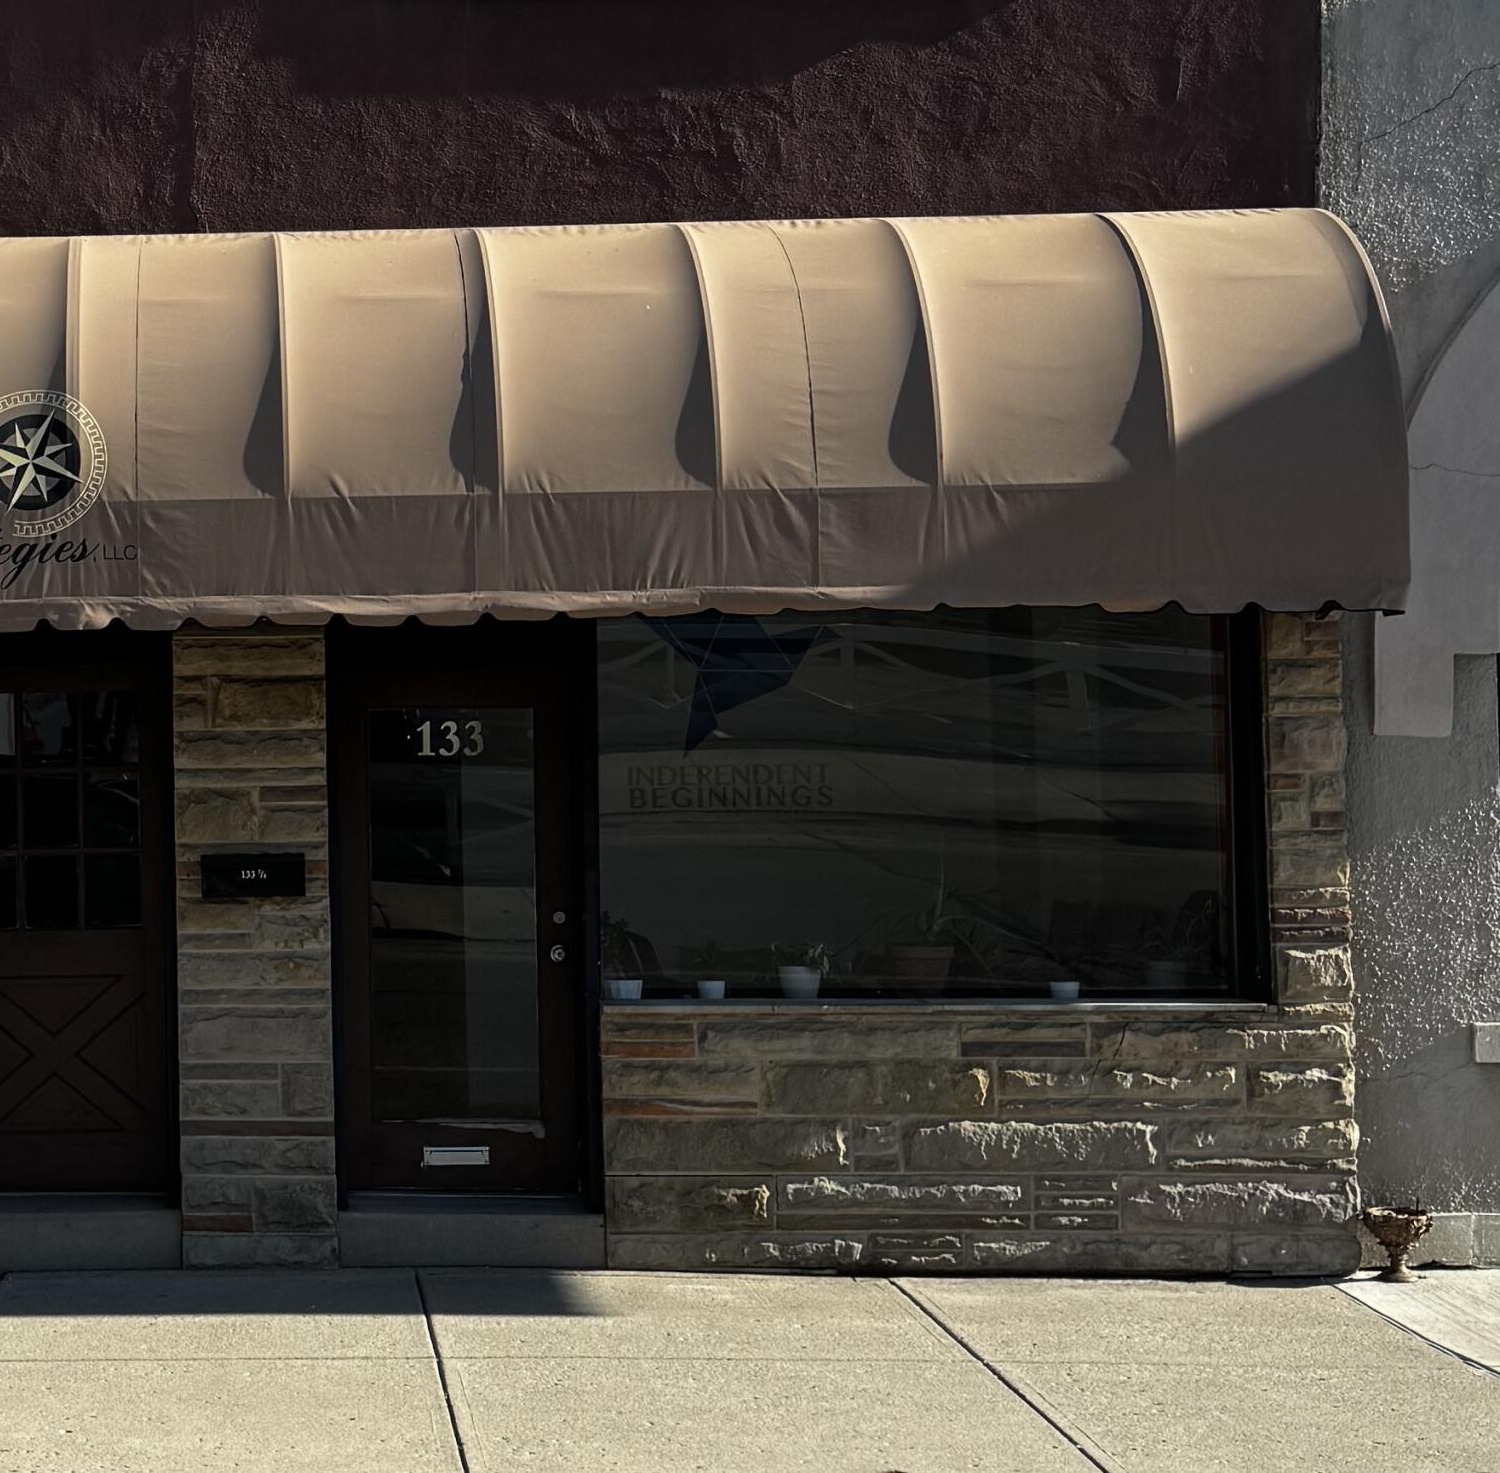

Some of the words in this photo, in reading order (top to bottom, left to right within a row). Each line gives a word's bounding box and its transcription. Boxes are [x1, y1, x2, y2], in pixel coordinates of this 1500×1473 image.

[103, 544, 138, 561] LLC
[416, 720, 485, 757] 133
[629, 785, 834, 809] BEGINNINGS
